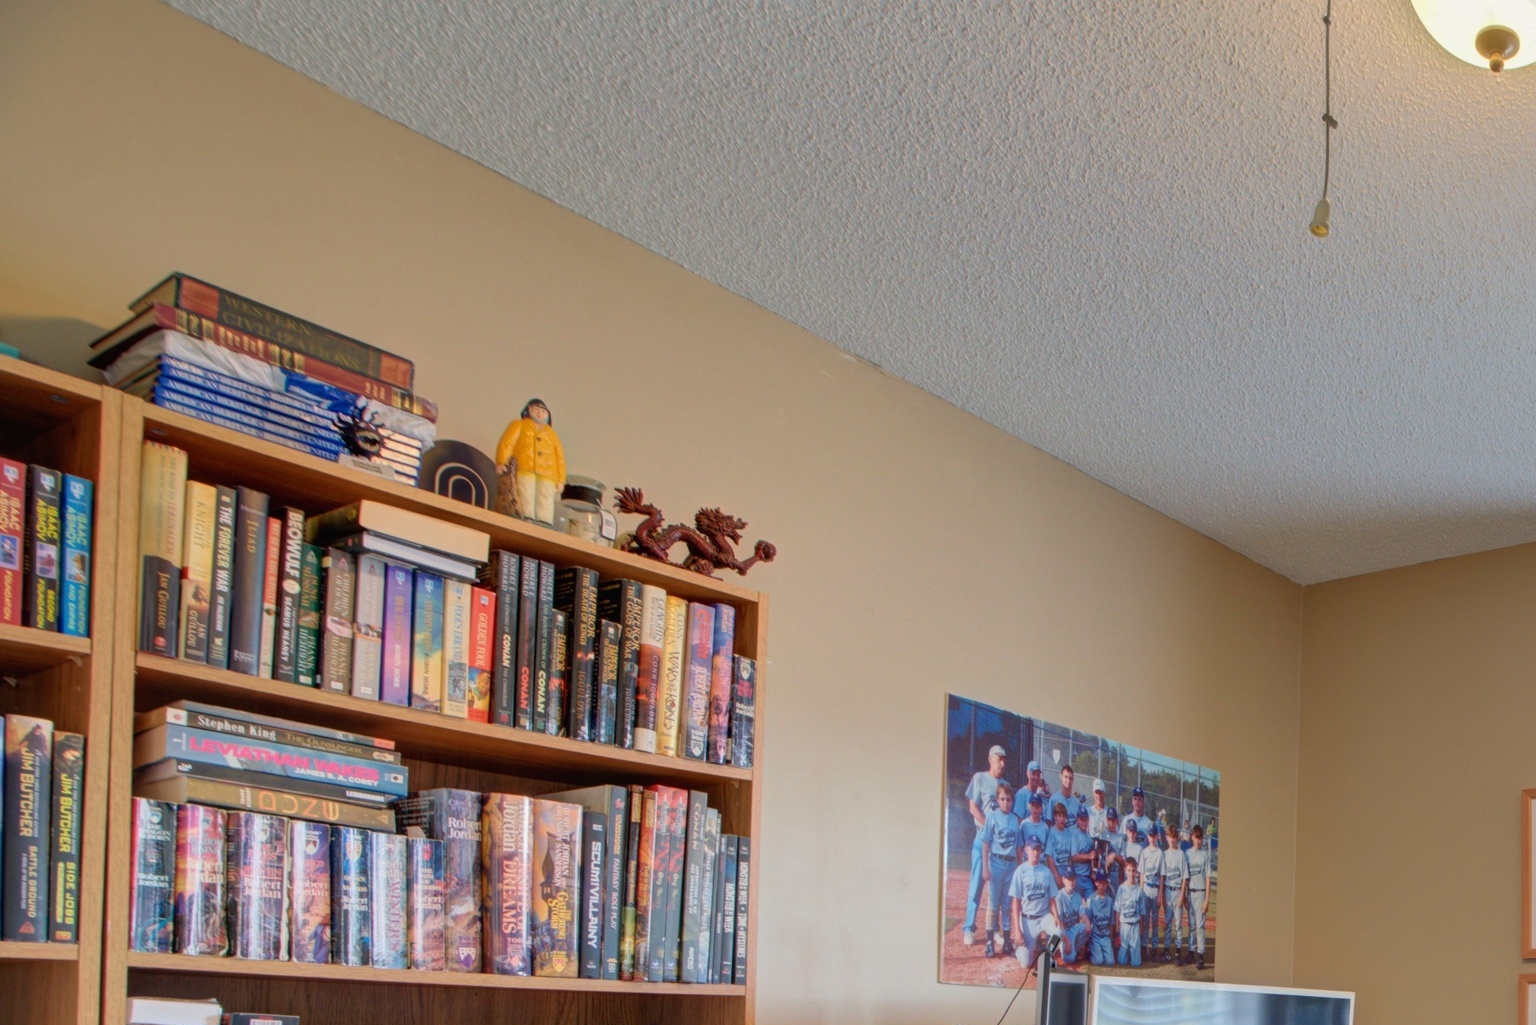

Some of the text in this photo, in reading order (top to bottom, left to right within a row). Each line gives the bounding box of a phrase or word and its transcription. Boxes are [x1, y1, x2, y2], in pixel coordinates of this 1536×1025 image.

[35, 498, 48, 542] ASIMOV
[47, 506, 59, 541] ISAAC
[286, 511, 302, 577] BEOWULF
[216, 507, 233, 592] THE FOREVER WAR
[581, 588, 591, 611] DEATH
[586, 587, 598, 638] EMPEROR
[625, 602, 635, 626] GODS
[187, 611, 198, 647] GUILLOU
[281, 597, 293, 662] SEAMUS HEANEY
[475, 613, 489, 668] GOLDEN FOOL
[630, 599, 642, 651] EMPEROR
[608, 645, 619, 681] EMPEROR
[623, 642, 633, 659] WAR
[666, 652, 681, 686] WARS
[519, 667, 530, 709] CONAN
[576, 671, 587, 721] IGGULDEN
[648, 683, 658, 730] IGGULDEN
[197, 715, 277, 742] Stephen King
[190, 736, 381, 784] LEVIATHAN WAKES
[295, 767, 380, 788] JAMES S. A. COREY
[19, 748, 36, 837] JIM BUTCHER
[59, 773, 73, 852] JIM BUTCHER
[502, 801, 519, 852] Jordan
[27, 846, 39, 917] BATTLE GROUND
[65, 862, 76, 925] SIDE JOBS
[502, 859, 518, 933] DREAMS
